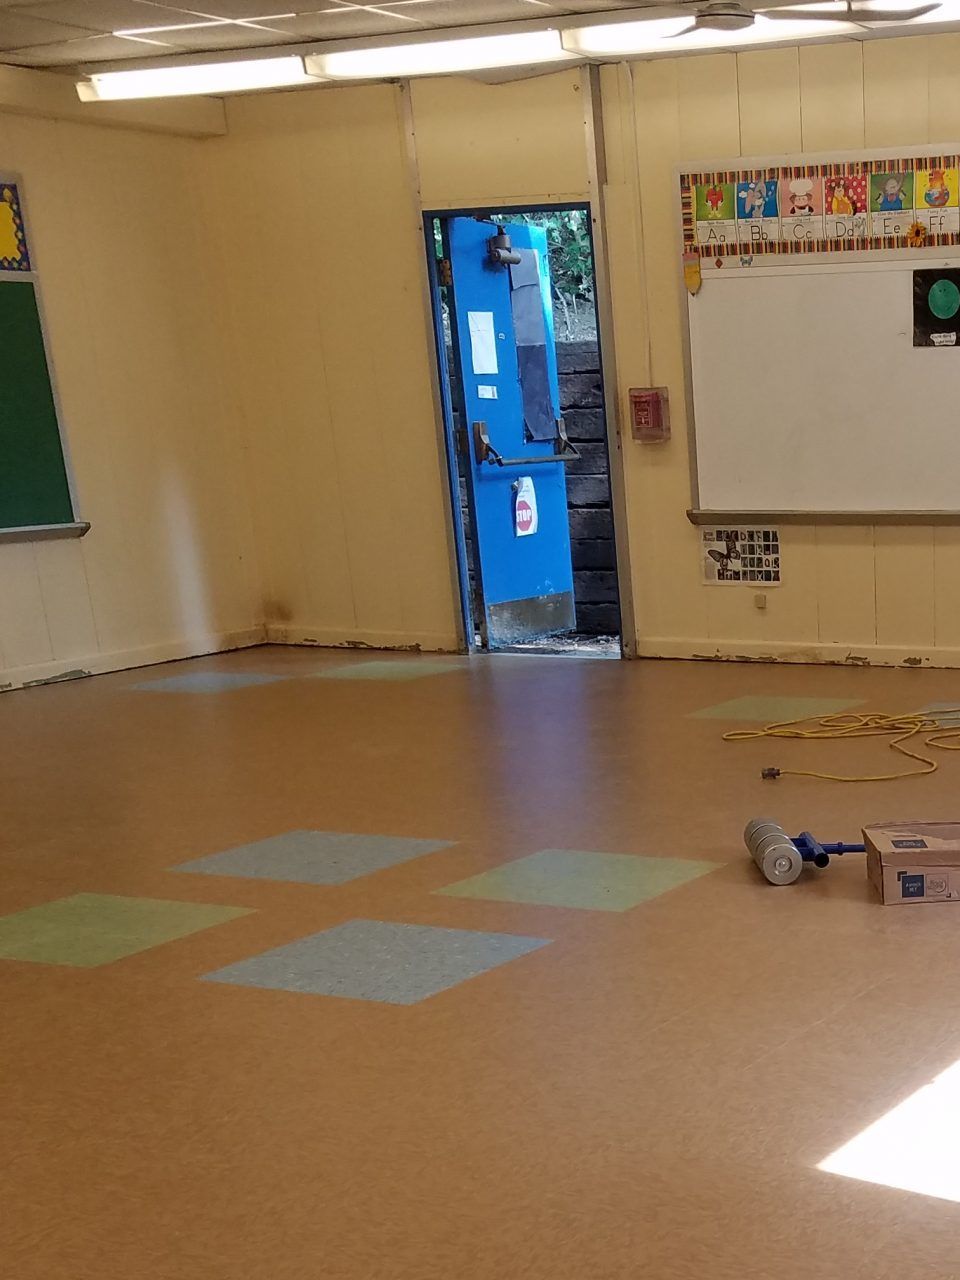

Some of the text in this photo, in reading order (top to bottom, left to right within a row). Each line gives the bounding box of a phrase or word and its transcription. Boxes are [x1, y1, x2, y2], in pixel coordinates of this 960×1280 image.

[792, 223, 813, 240] Cc
[835, 220, 855, 238] Dd
[883, 217, 901, 235] Ee
[929, 215, 946, 233] Ff
[707, 228, 726, 243] Aa
[750, 225, 769, 241] Bb
[516, 508, 532, 523] STOP
